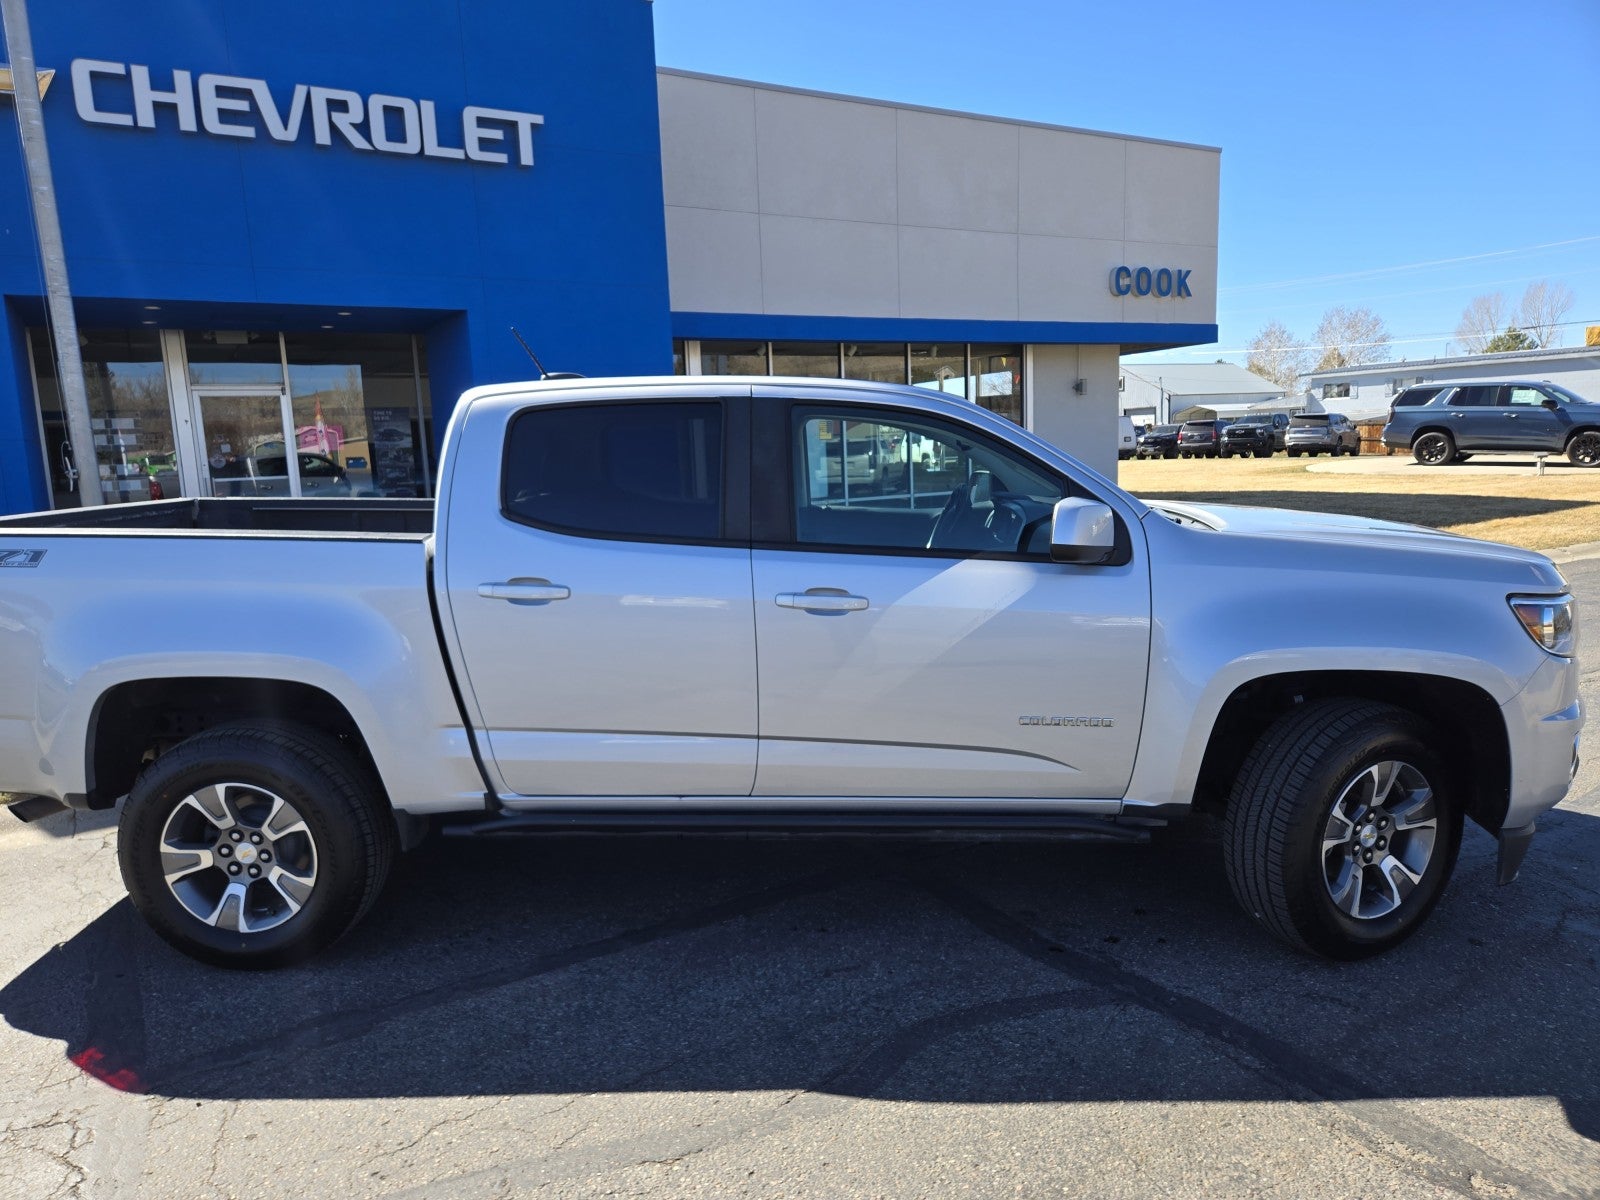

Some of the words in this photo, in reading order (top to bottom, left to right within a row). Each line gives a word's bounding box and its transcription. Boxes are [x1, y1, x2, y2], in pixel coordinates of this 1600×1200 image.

[70, 57, 545, 166] CHEVROLET
[1113, 265, 1192, 297] COOK
[1018, 715, 1114, 728] COLORADO
